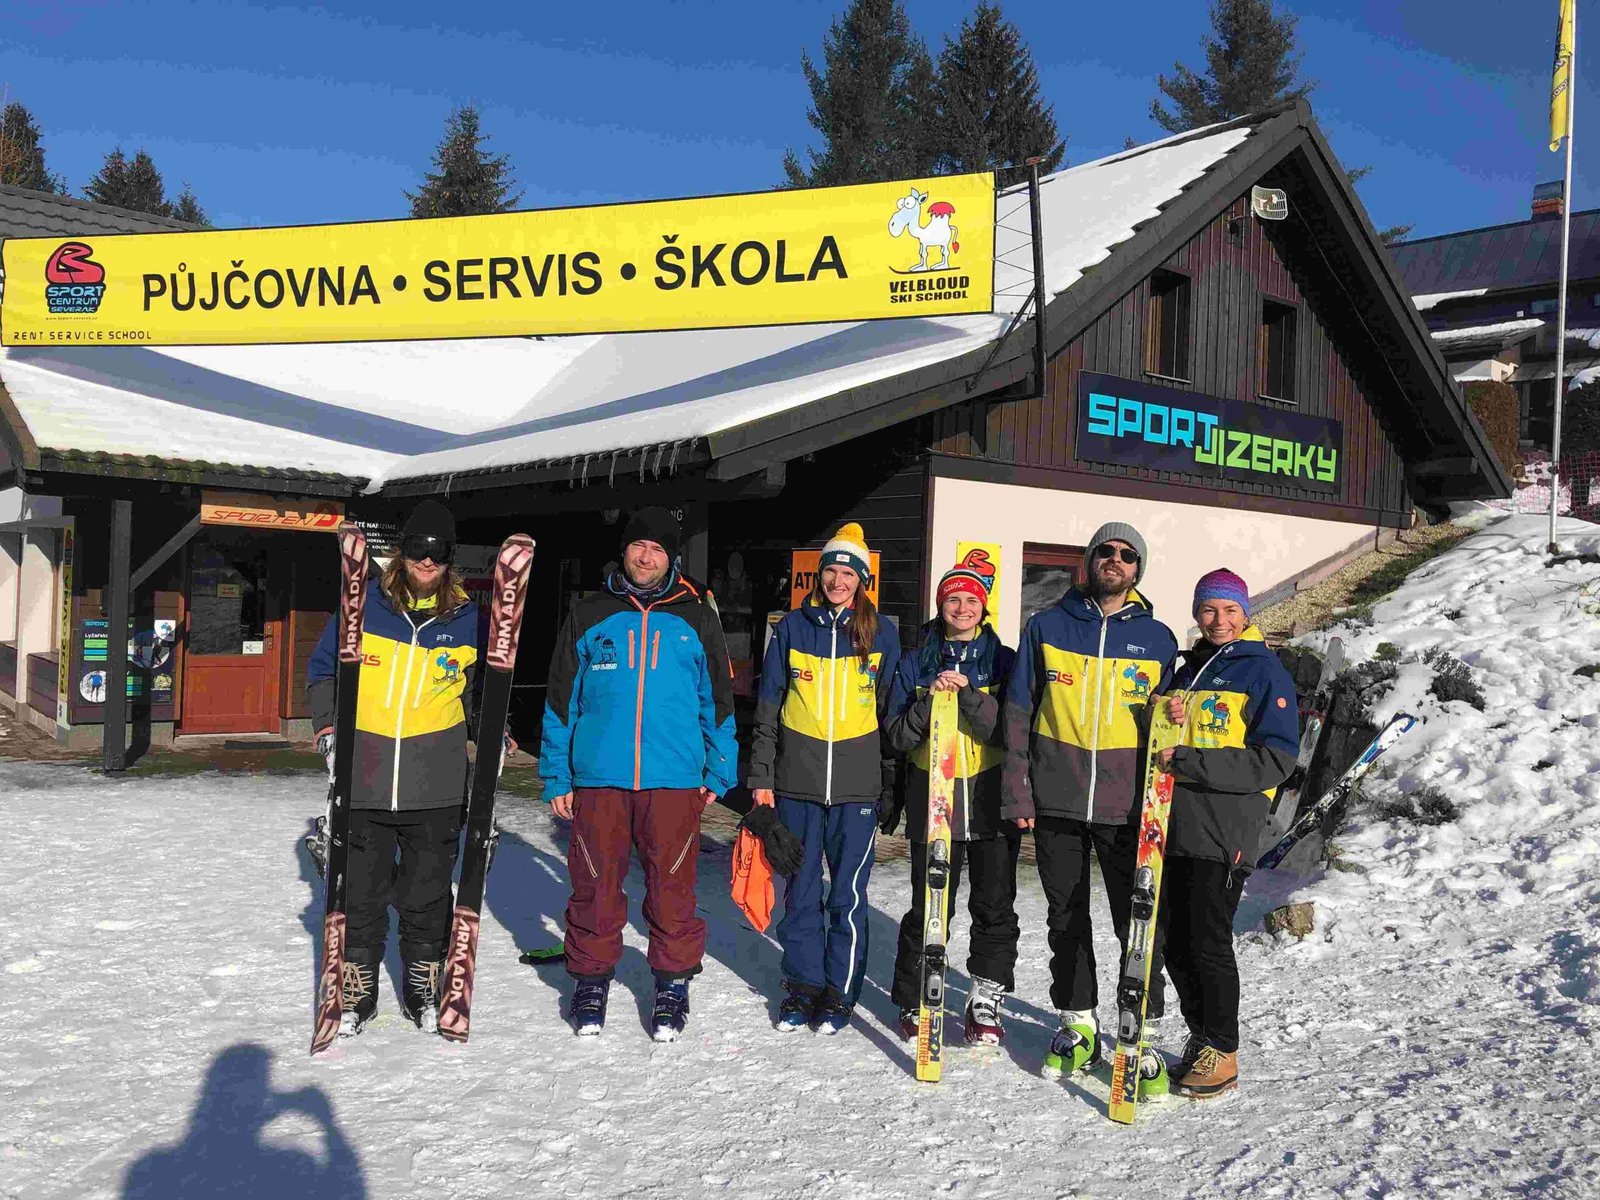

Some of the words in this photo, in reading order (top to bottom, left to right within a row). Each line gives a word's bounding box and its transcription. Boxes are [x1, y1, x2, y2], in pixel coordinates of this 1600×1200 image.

[143, 260, 381, 311] PŮJČOVNA
[423, 251, 603, 302] SERVIS
[654, 234, 849, 290] ŠKOLA
[47, 286, 104, 297] SPORT
[889, 276, 970, 293] VELBLOUD
[49, 297, 99, 306] CENTRUM
[890, 294, 912, 303] SKI
[916, 290, 968, 301] SCHOOL
[13, 332, 44, 340] RENT
[49, 331, 103, 340] SERVICE
[109, 330, 152, 340] SCHOOL
[1088, 393, 1219, 450] SPORT
[1195, 427, 1337, 483] JIZERKY
[209, 509, 315, 527] SPORTEN
[342, 567, 362, 661] ARMADA
[489, 576, 519, 664] ARMADA
[360, 654, 382, 667] LS
[791, 667, 814, 682] SLS
[1046, 669, 1074, 686] SLS
[449, 917, 471, 1003] ARMADA
